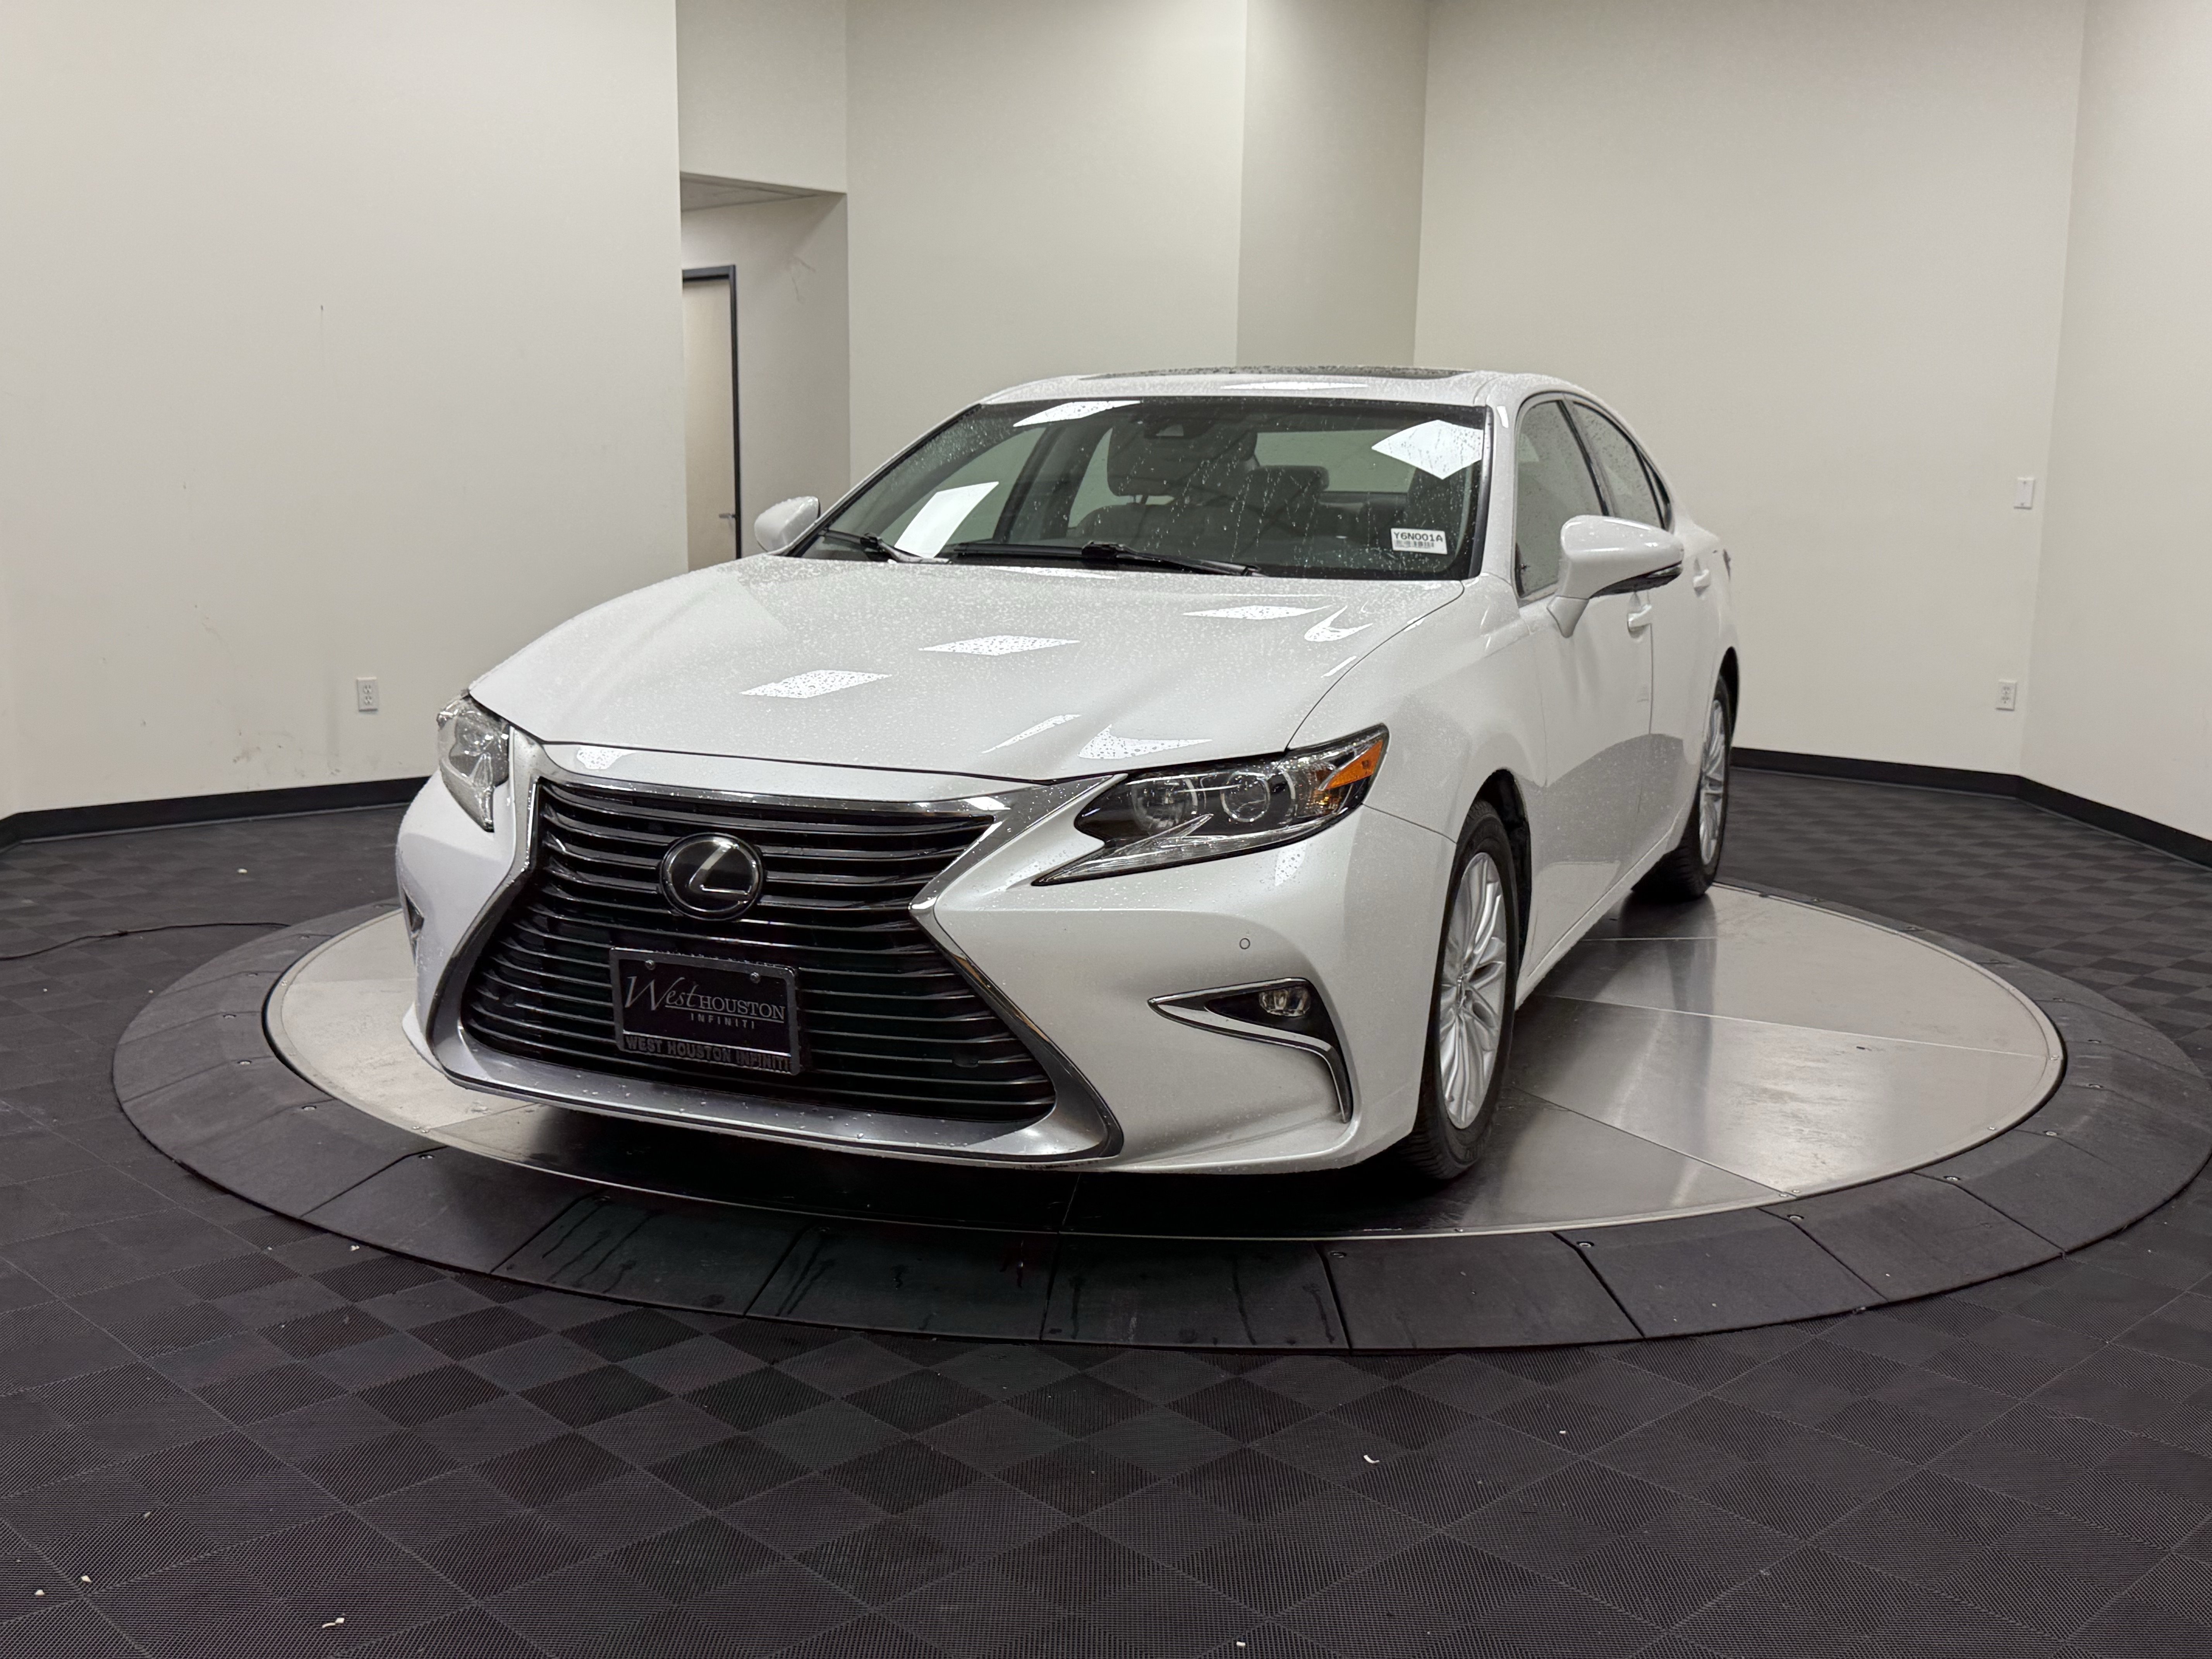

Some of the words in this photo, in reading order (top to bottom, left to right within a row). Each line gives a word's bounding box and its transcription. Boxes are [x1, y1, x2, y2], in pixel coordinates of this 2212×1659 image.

[1394, 532, 1443, 542] Y6N001A
[625, 976, 700, 1011] West
[699, 996, 785, 1020] HOUSTON
[691, 1013, 755, 1029] INFINITI
[625, 1036, 663, 1053] WEST
[667, 1043, 731, 1062] HOUSTON
[736, 1050, 791, 1071] INFINITI
